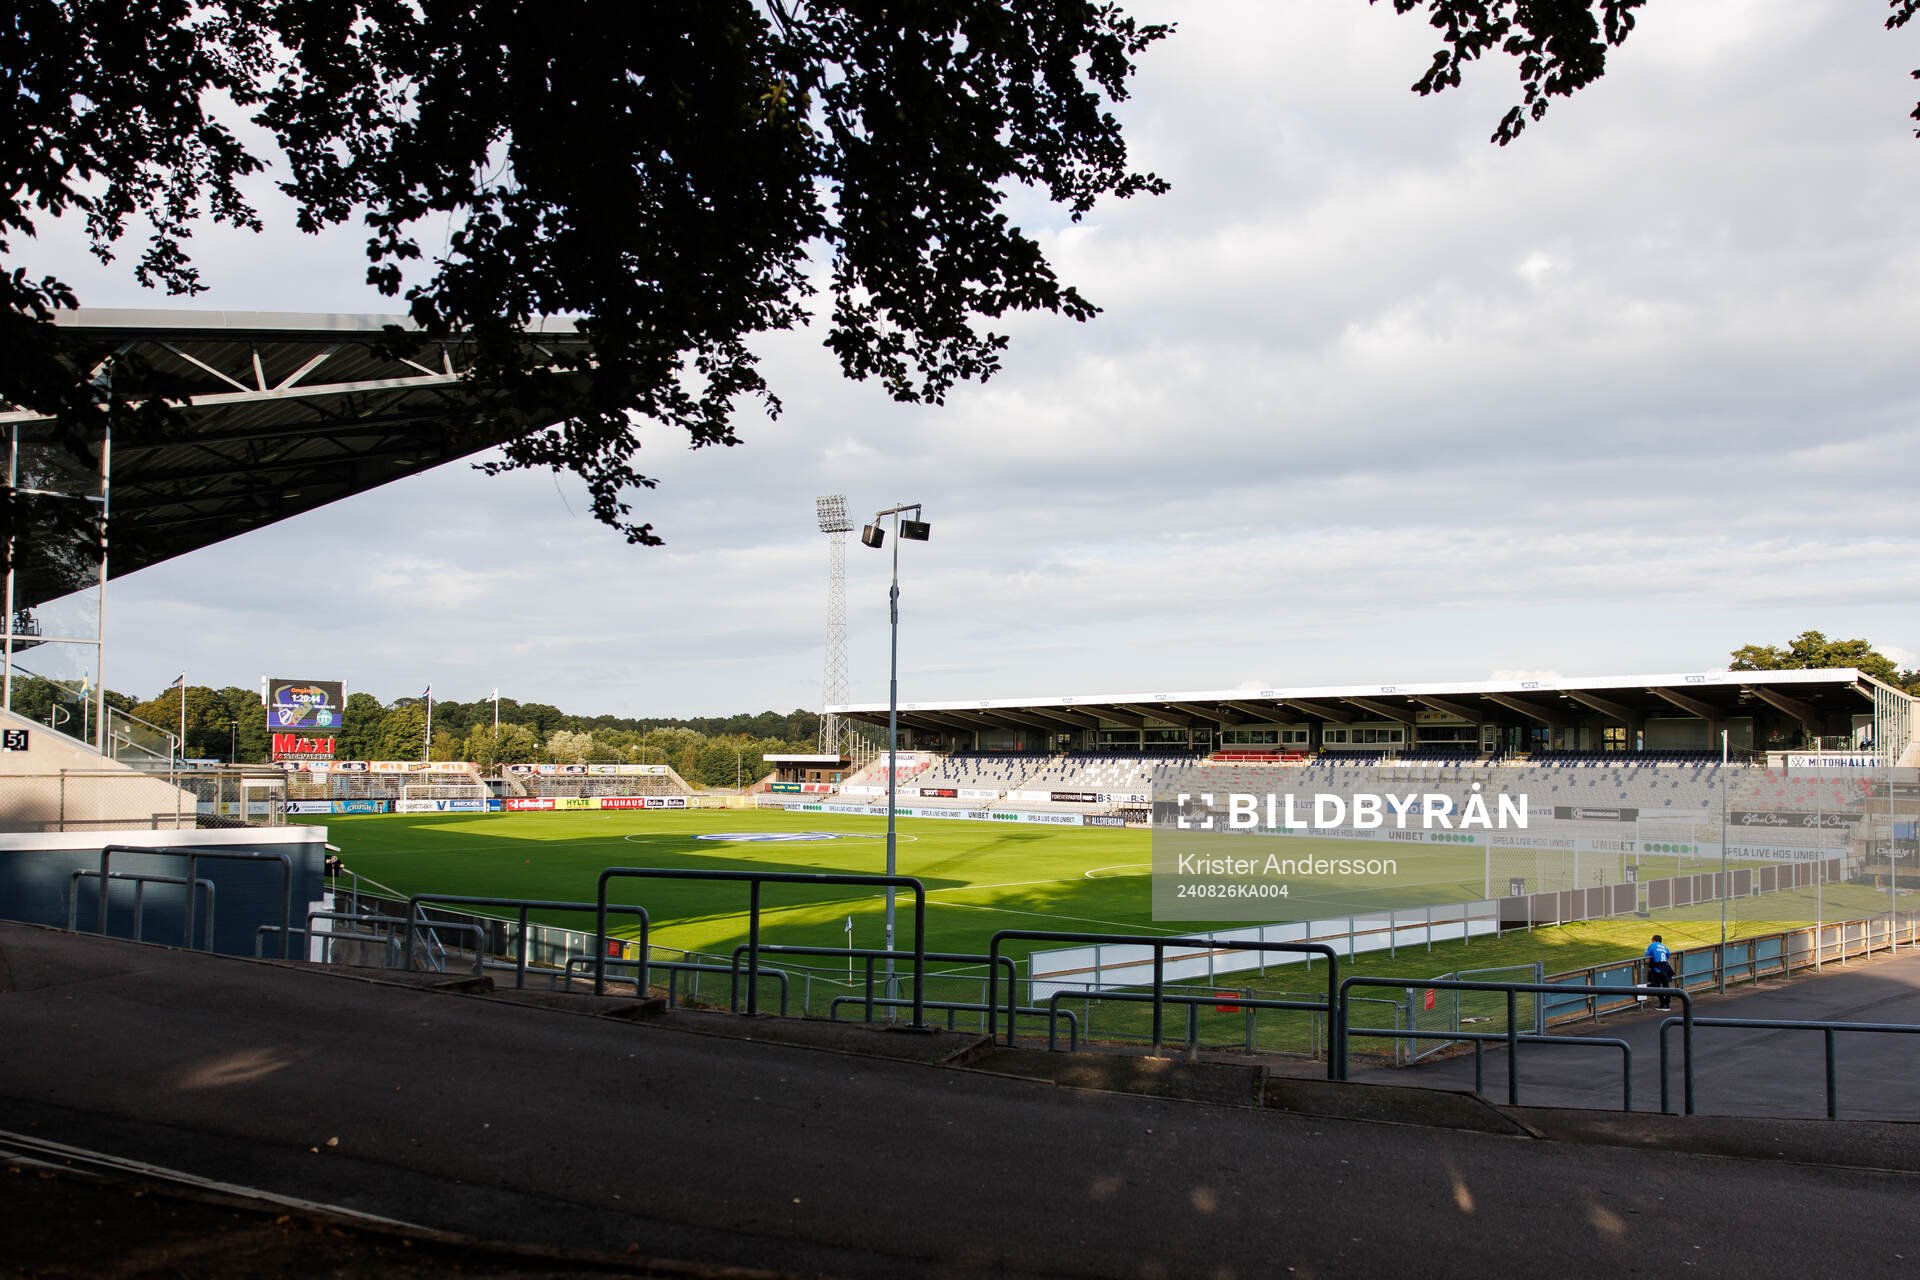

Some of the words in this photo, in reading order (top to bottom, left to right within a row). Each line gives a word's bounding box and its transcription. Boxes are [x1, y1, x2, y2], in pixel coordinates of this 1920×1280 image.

[7, 734, 25, 747] 51
[273, 734, 335, 753] MAXI
[602, 799, 644, 807] BAUHAUS
[869, 807, 888, 815] UNIBET
[968, 811, 989, 819] UNIBET
[1308, 827, 1326, 836] SPELA
[1327, 828, 1340, 836] LIVE
[1341, 829, 1354, 837] HOS
[1354, 830, 1376, 838] UNIBET
[1388, 831, 1424, 841] UNIBET
[1492, 836, 1513, 845] SPELA
[1516, 837, 1532, 846] LIVE
[1533, 838, 1548, 847] HOS
[1591, 839, 1636, 851] UNIBET
[1751, 849, 1772, 858] LIVE
[1773, 850, 1791, 859] HOS
